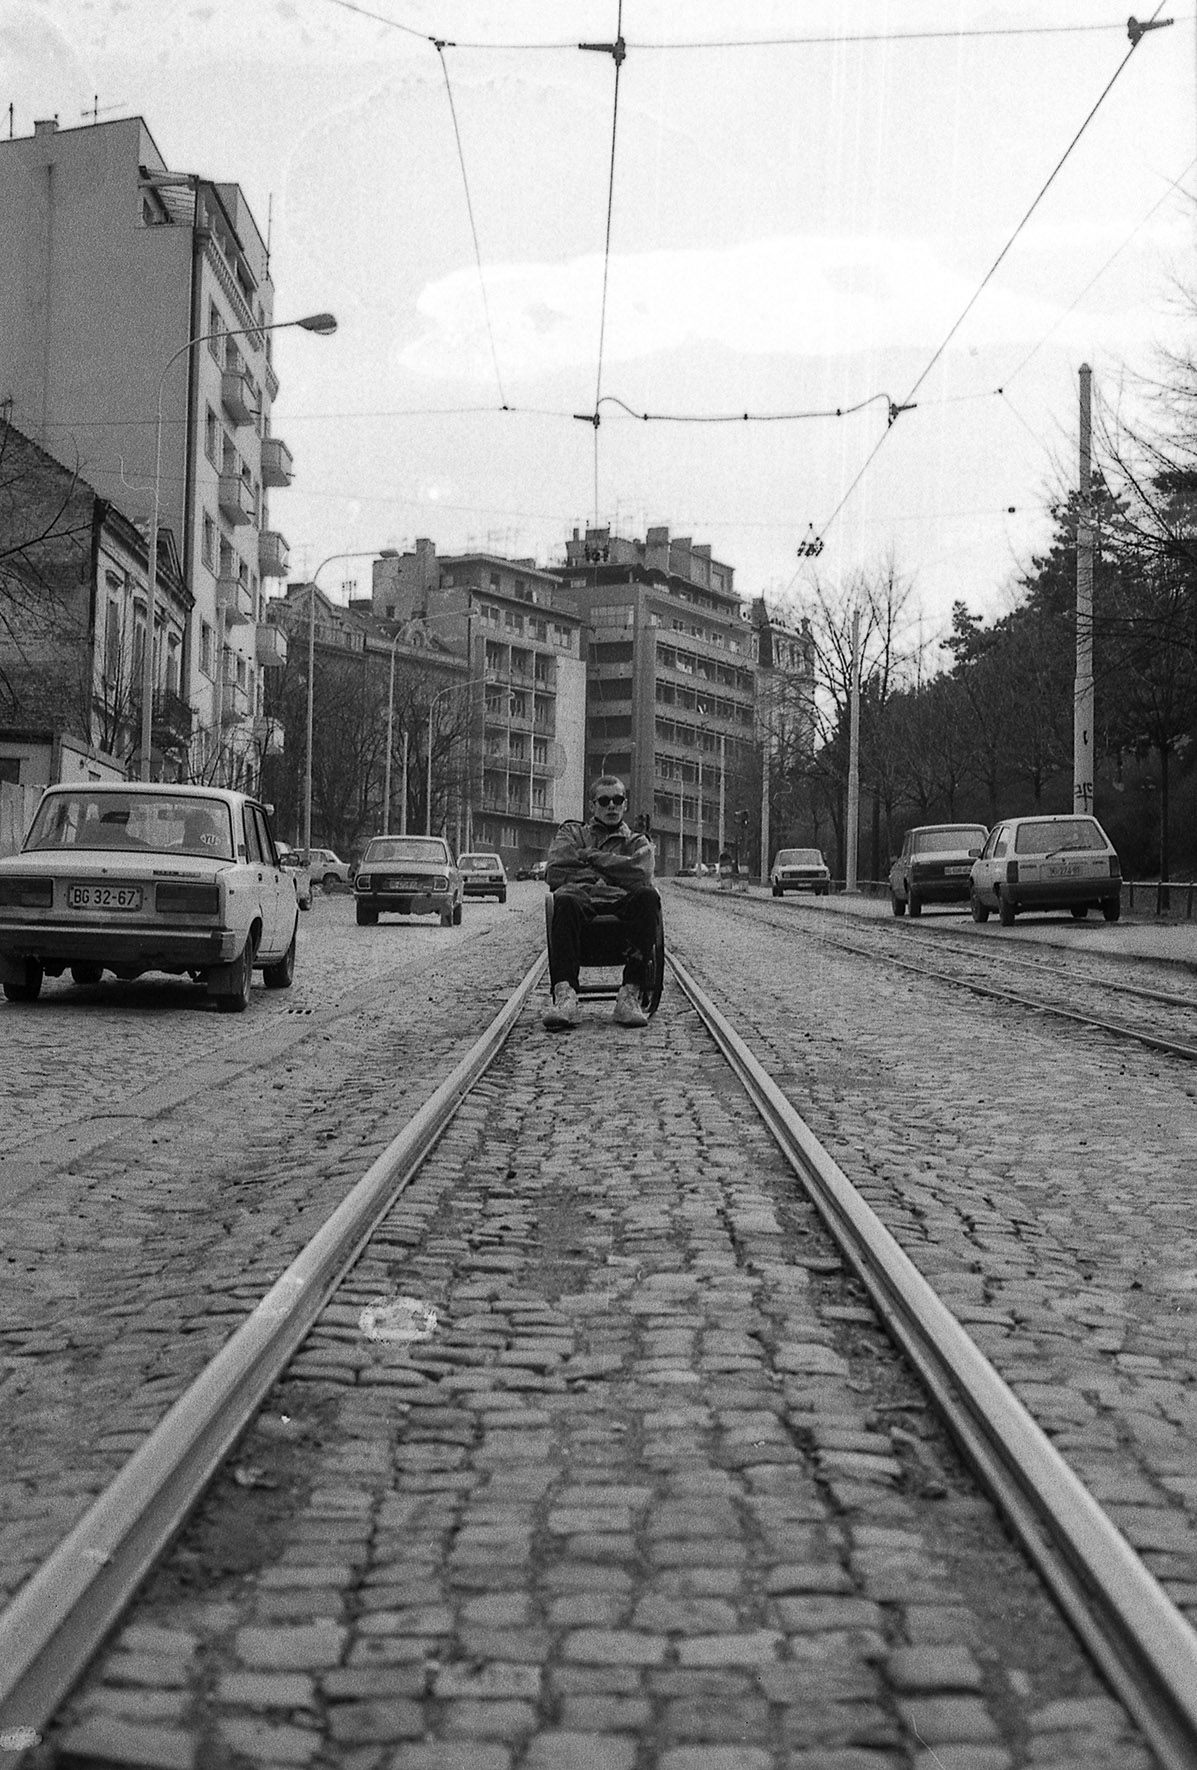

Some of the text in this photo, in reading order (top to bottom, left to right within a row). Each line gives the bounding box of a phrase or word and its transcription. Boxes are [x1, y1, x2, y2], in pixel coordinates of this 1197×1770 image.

[205, 834, 217, 845] YU
[74, 888, 136, 906] BG 32-67
